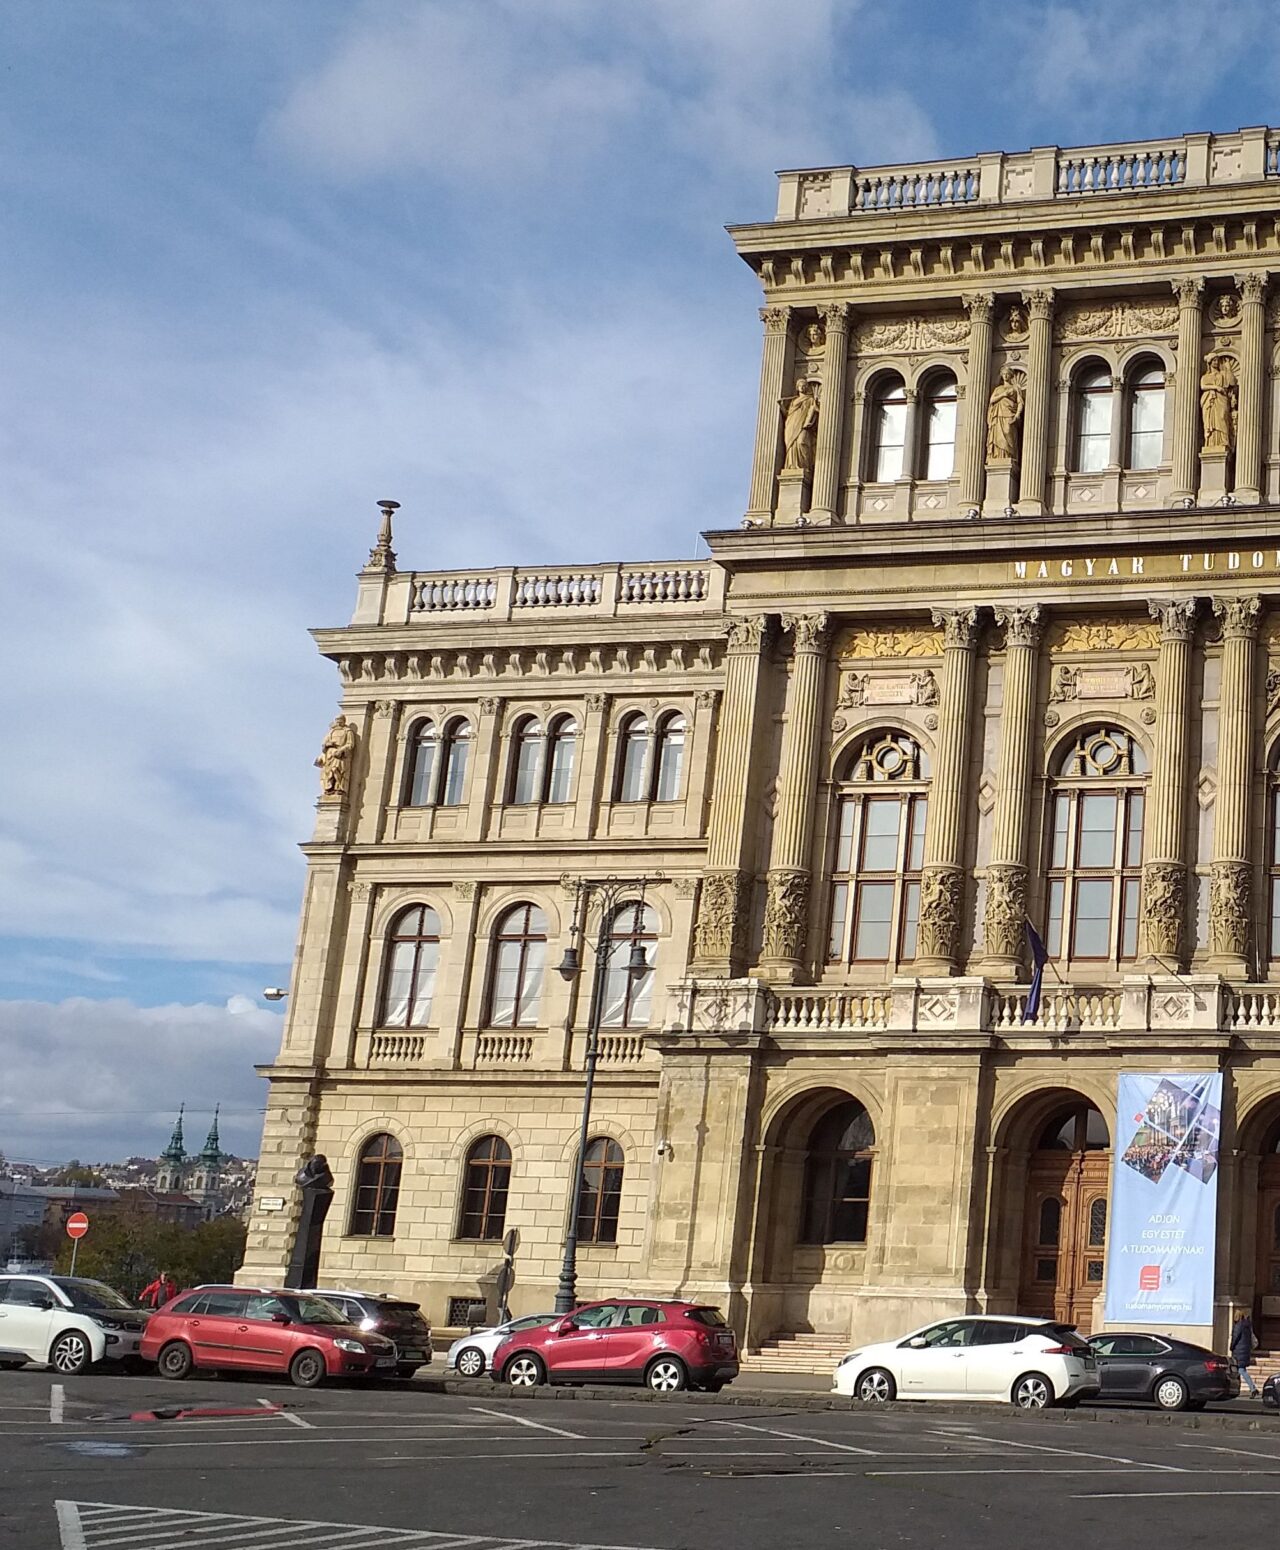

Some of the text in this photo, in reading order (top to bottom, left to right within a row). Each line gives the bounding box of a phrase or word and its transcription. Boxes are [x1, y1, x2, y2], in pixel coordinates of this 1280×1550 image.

[1014, 557, 1144, 579] MAGYAR
[1148, 1214, 1181, 1224] ADJON
[1142, 1229, 1160, 1239] EGY
[1120, 1245, 1128, 1253] A
